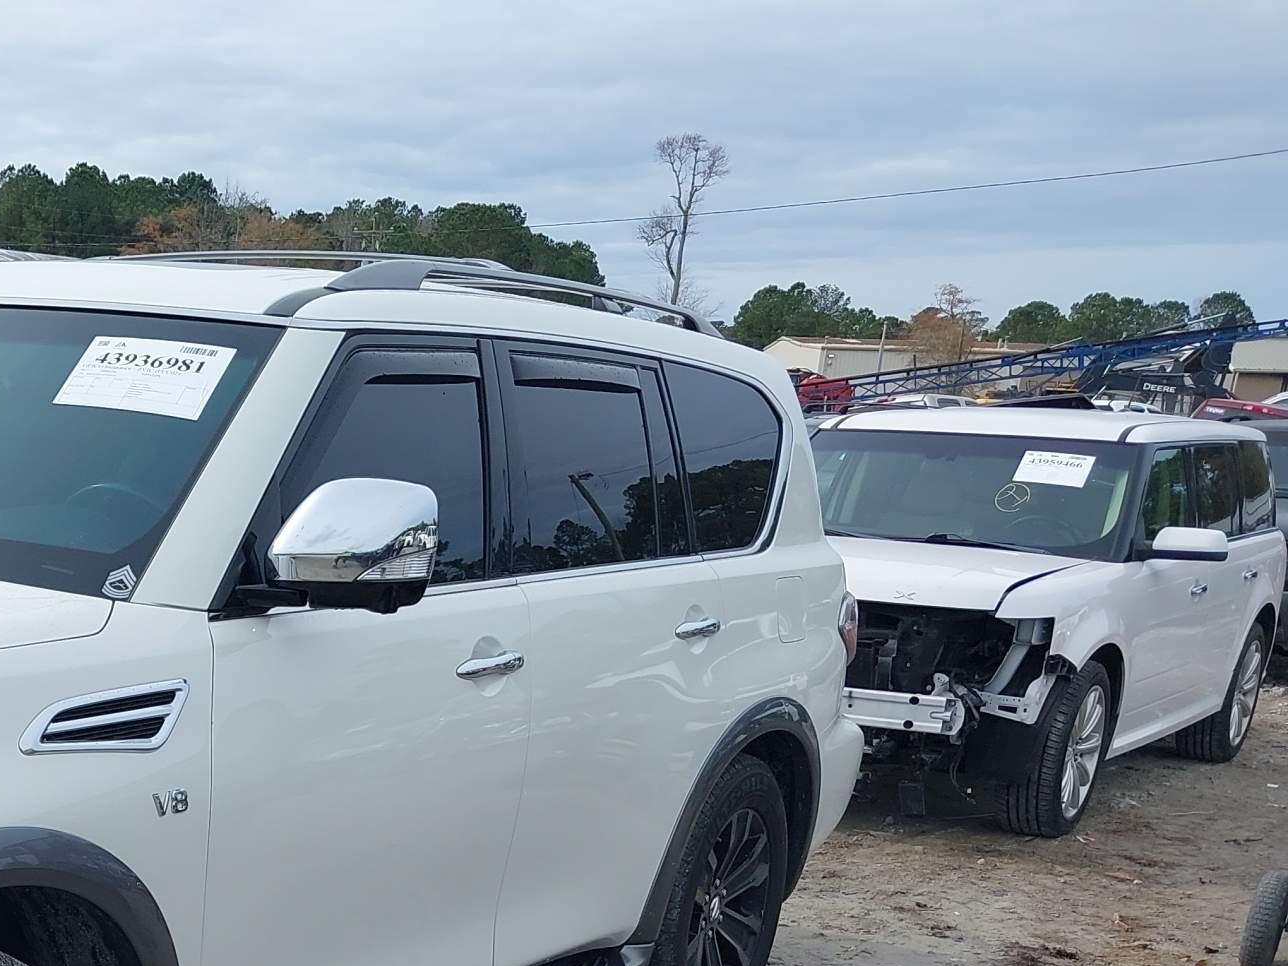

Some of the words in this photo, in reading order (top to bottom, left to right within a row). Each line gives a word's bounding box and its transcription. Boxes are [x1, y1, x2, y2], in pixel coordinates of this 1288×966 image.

[96, 352, 206, 374] 43936981
[1143, 382, 1176, 393] DEERE
[152, 789, 188, 816] V8
